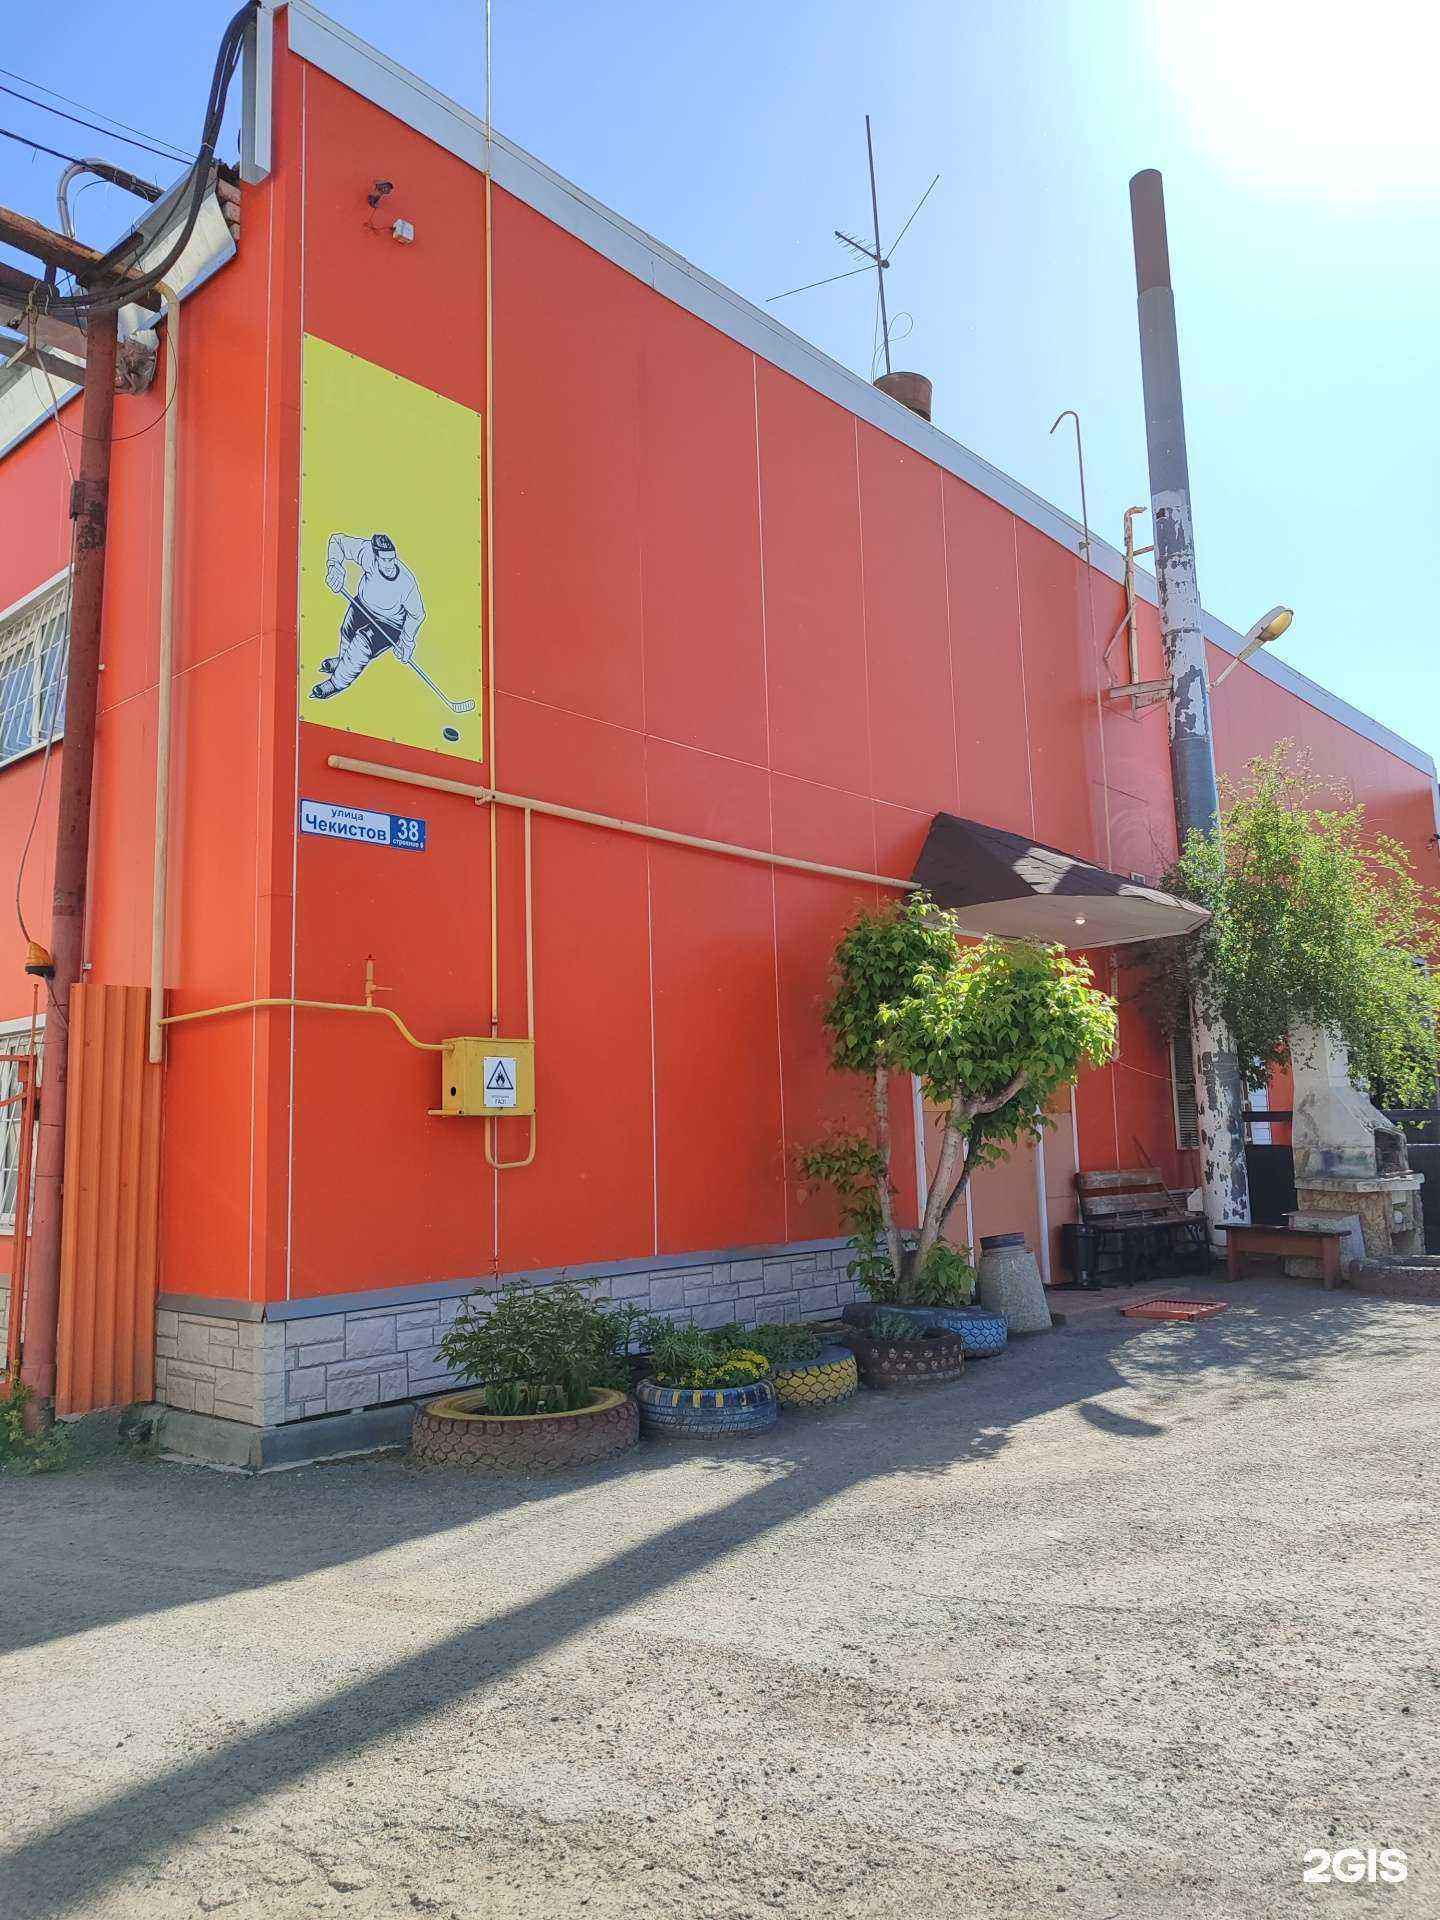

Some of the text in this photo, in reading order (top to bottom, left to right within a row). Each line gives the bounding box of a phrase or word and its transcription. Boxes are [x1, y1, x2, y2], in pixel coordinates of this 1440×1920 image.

[331, 809, 363, 821] улица
[305, 814, 387, 840] Чекистов
[398, 819, 419, 841] 38
